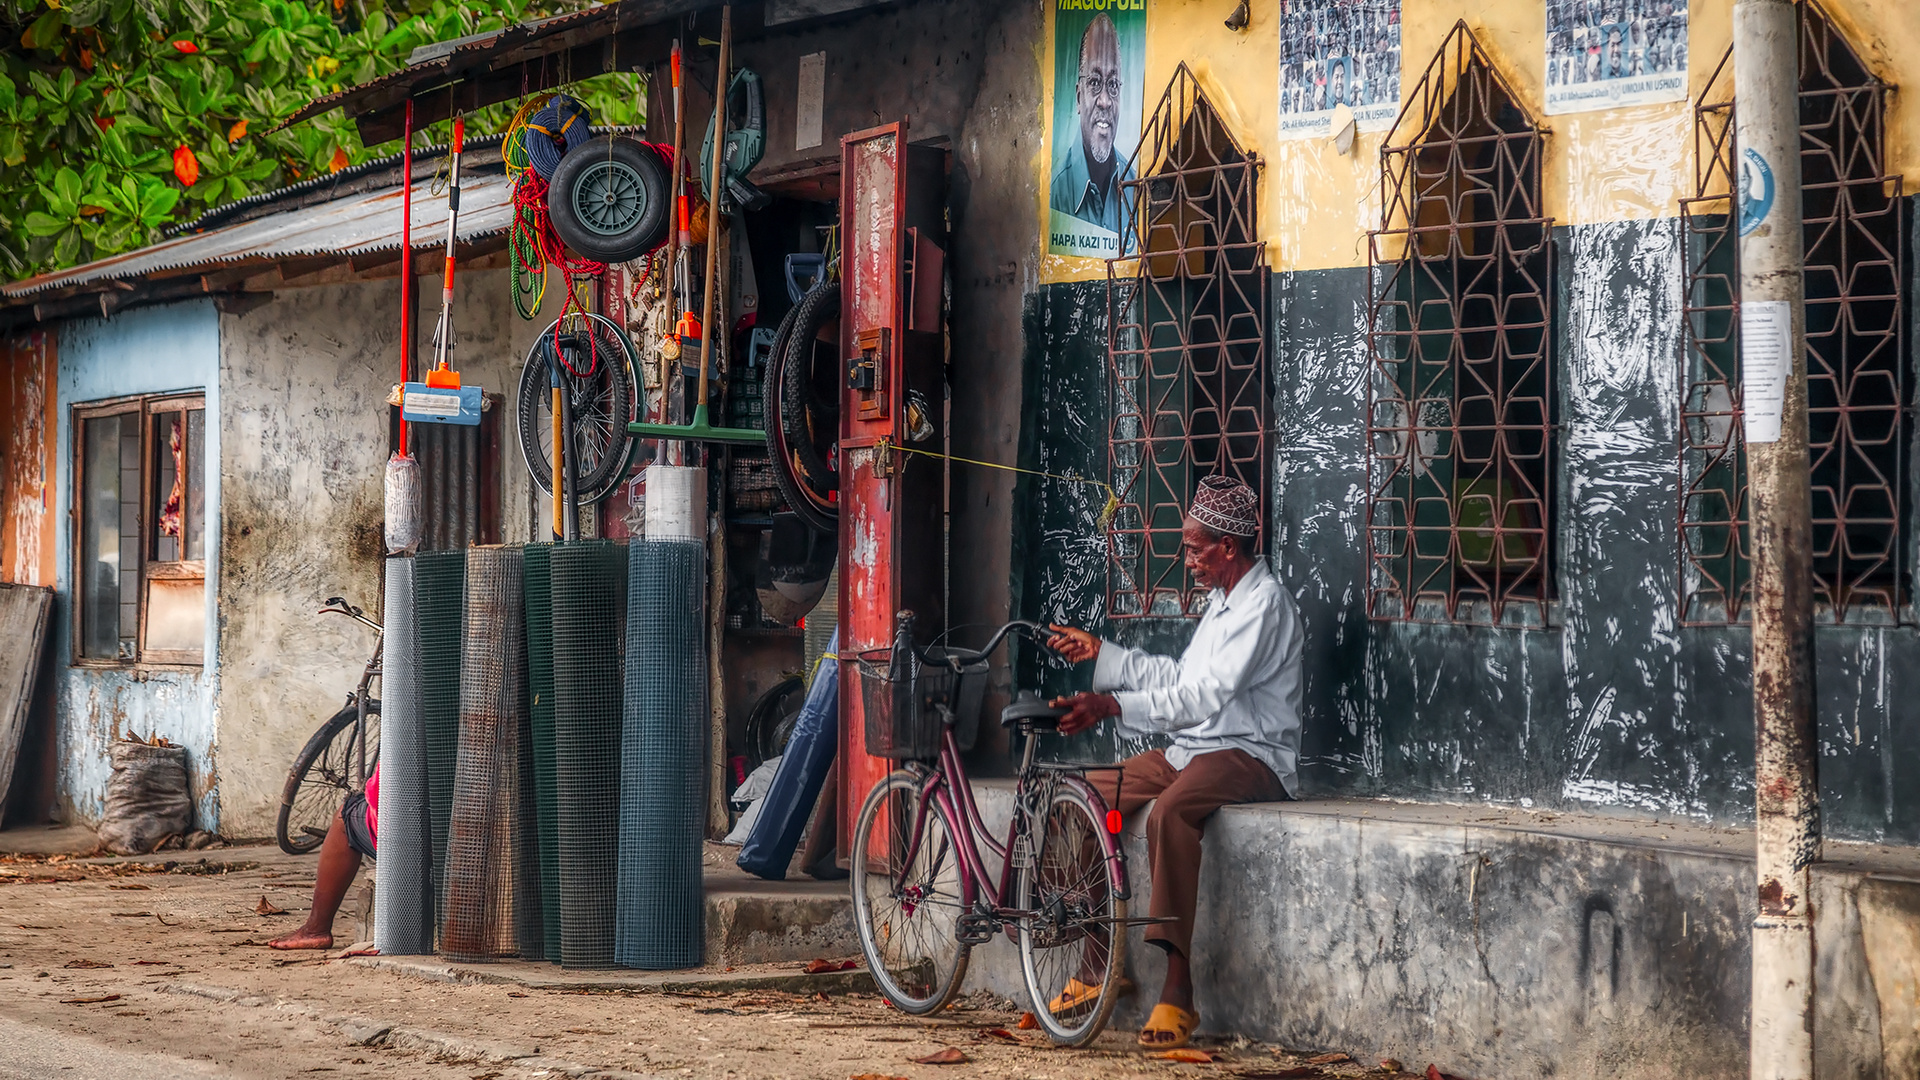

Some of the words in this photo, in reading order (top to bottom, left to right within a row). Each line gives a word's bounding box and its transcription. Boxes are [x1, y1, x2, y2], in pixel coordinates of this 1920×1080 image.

[1621, 83, 1645, 94] UMOJA
[1645, 82, 1653, 92] NI
[1654, 77, 1683, 90] USHINDI
[1321, 116, 1331, 126] She
[1353, 111, 1364, 122] OJA
[1371, 107, 1396, 120] USHINDI
[1051, 233, 1076, 247] HAPA
[1079, 235, 1099, 249] KAZI
[1102, 237, 1118, 250] TU!
